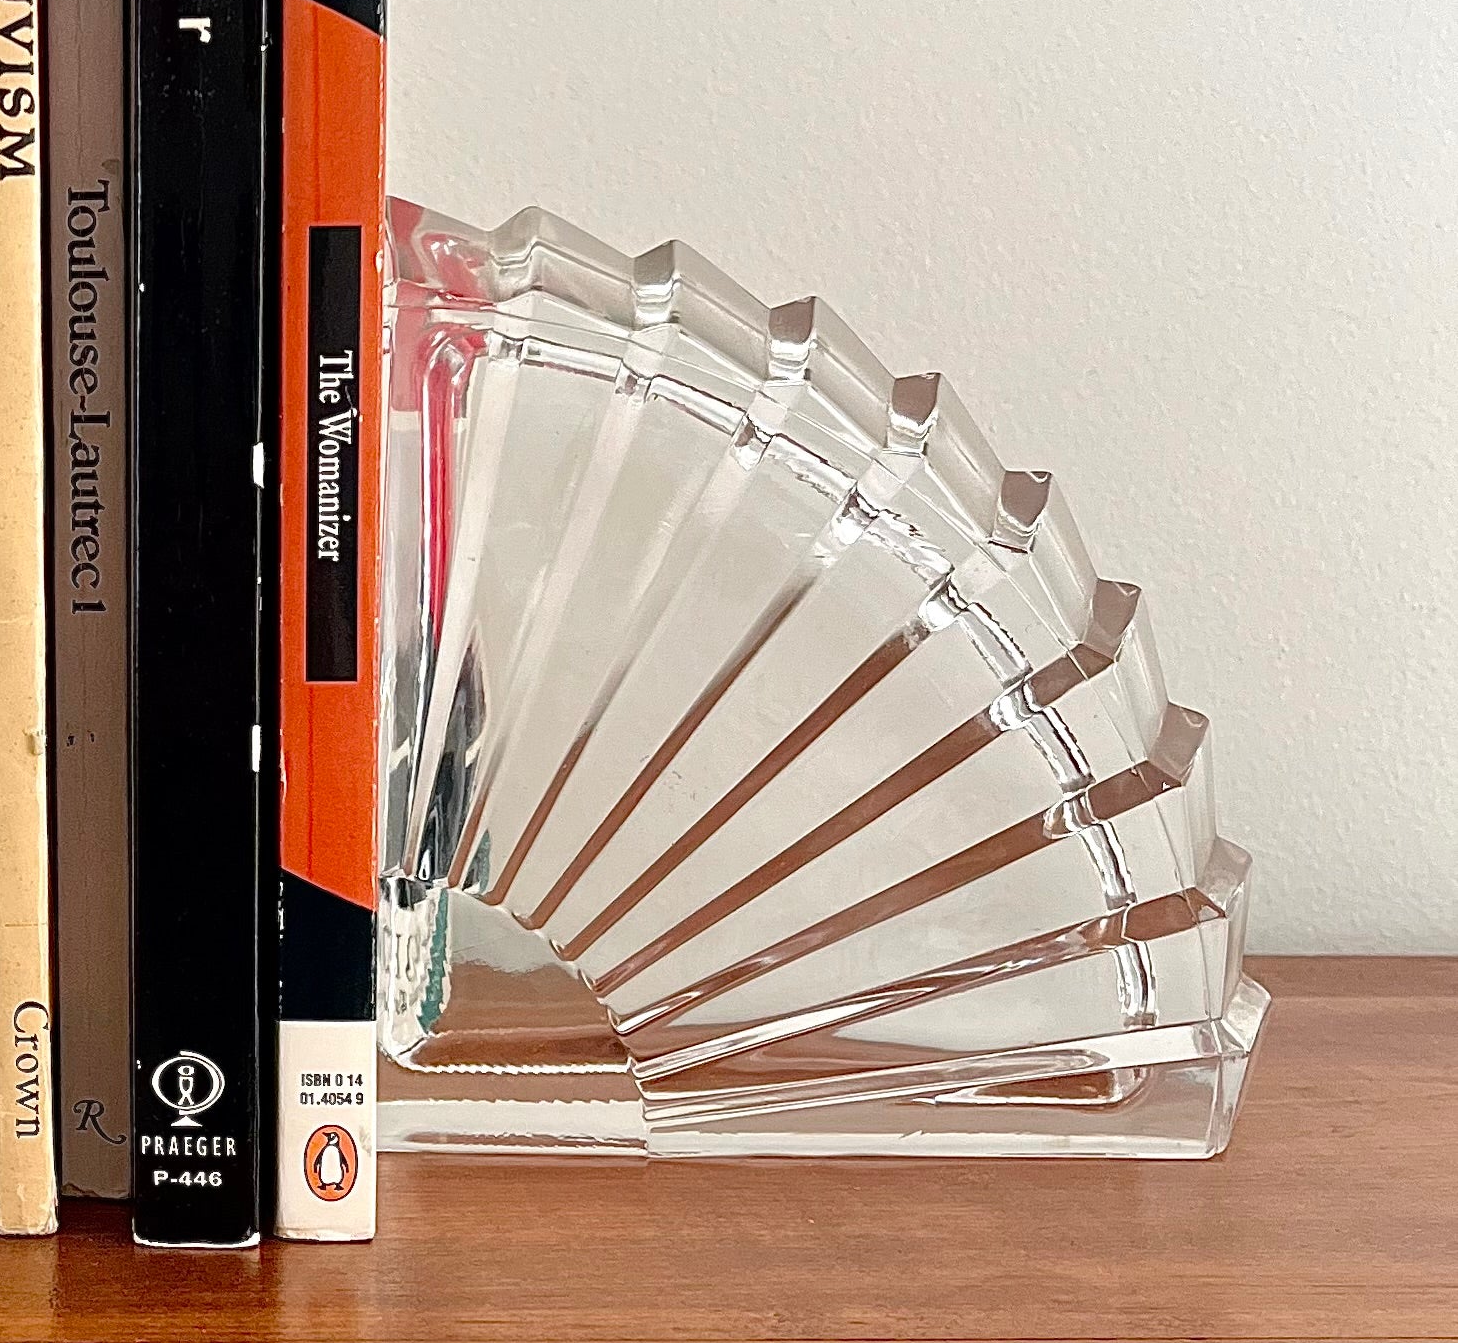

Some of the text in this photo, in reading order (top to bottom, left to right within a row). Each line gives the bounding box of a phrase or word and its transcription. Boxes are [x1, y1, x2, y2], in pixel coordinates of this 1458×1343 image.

[67, 179, 111, 616] Toulouse-Lautrec 1
[317, 349, 358, 562] The Womanizer
[13, 1000, 51, 1139] Crown
[301, 1073, 364, 1087] ISBN 0 14
[355, 1092, 364, 1106] 9
[73, 1099, 127, 1145] R
[141, 1135, 237, 1157] PRAEGER
[153, 1170, 223, 1187] P-446
